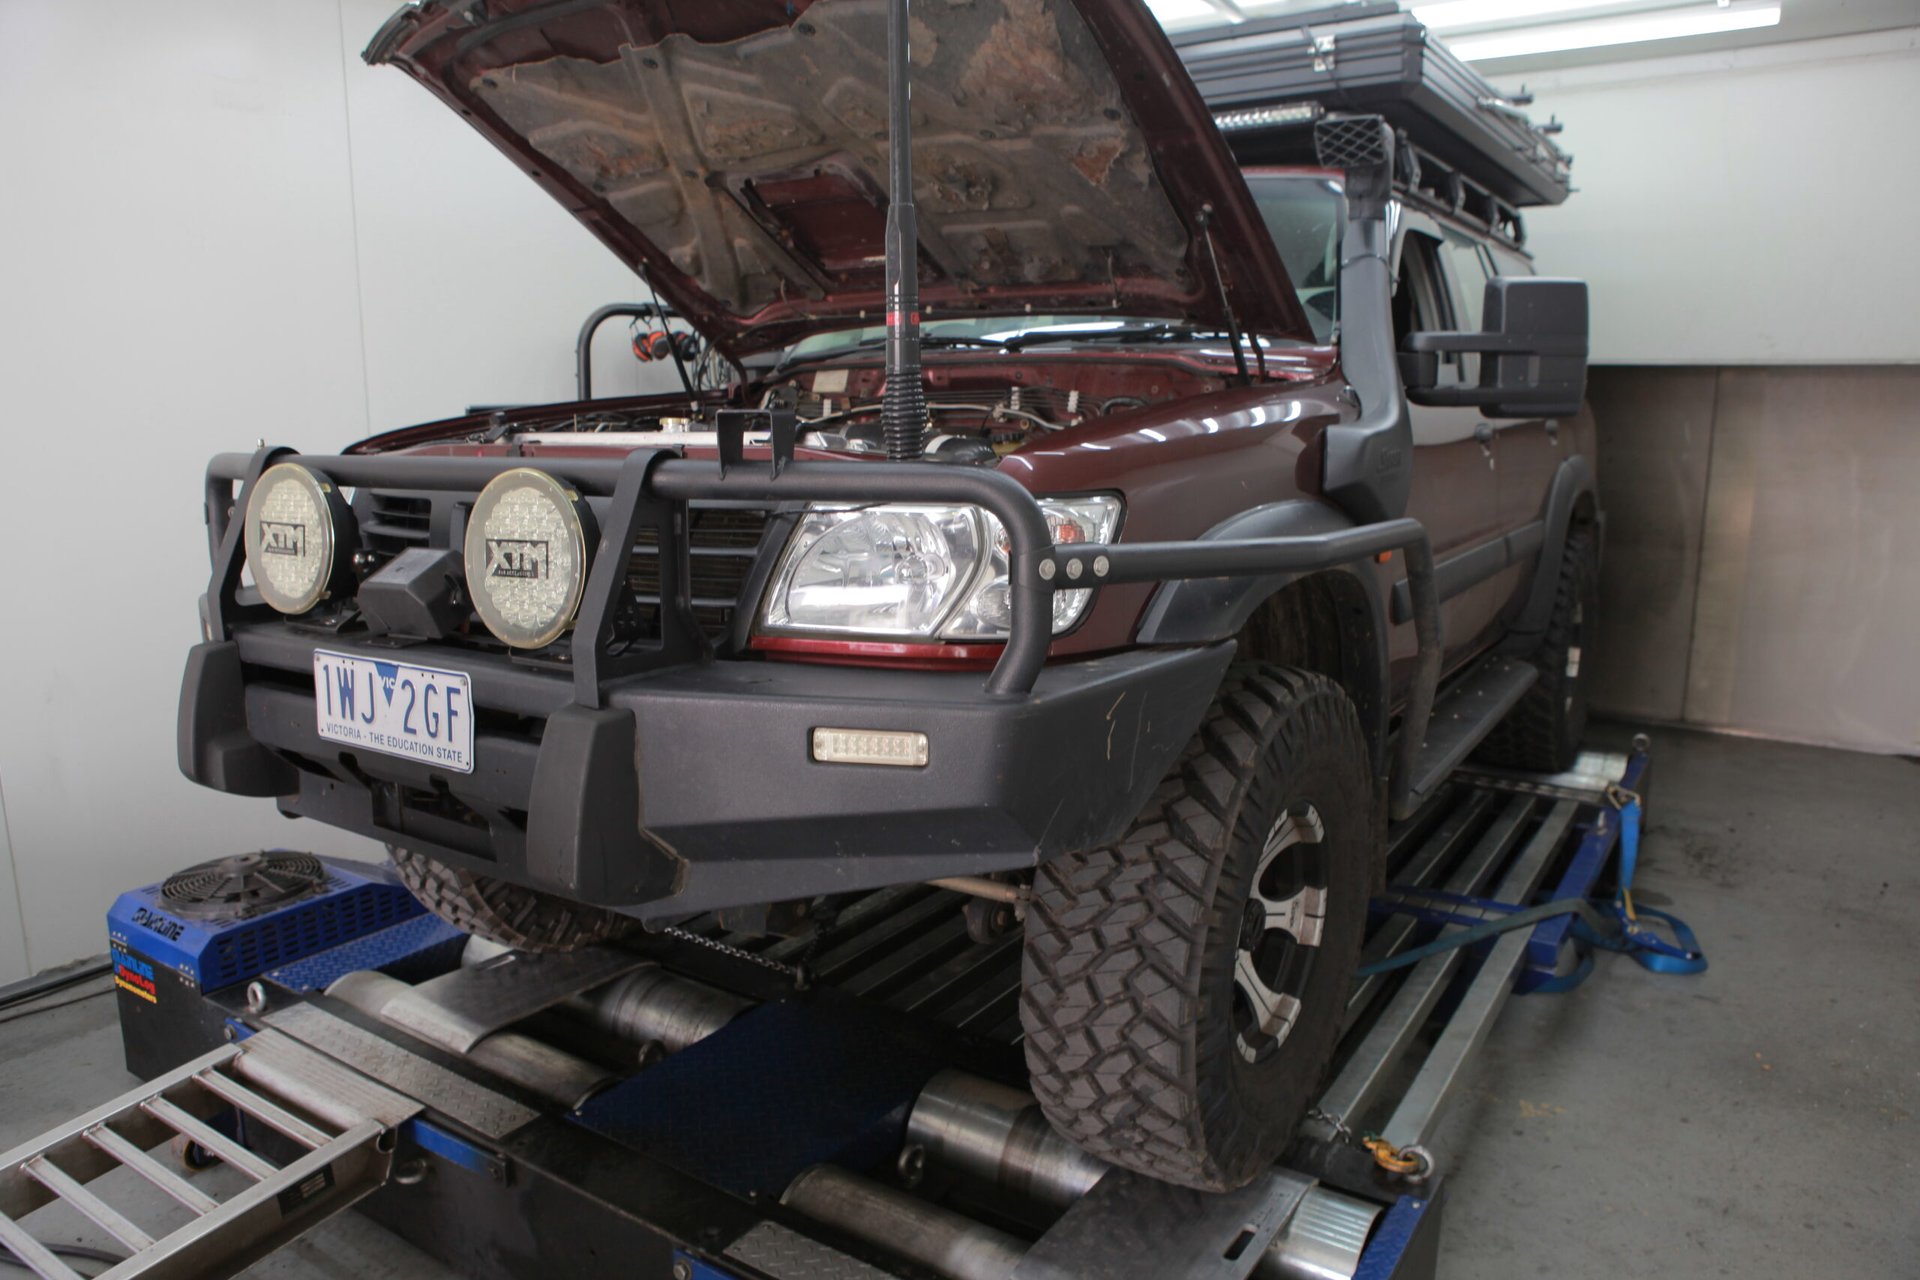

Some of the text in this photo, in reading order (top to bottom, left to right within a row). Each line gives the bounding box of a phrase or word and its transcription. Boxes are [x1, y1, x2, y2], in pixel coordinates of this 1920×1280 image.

[260, 522, 304, 557] XTM
[486, 540, 546, 578] XTM
[381, 676, 396, 689] VIC
[323, 664, 461, 742] 1WJ 2GF
[326, 723, 362, 740] VICTORIA
[369, 732, 385, 745] THE
[387, 735, 434, 757] EDUCATION
[436, 747, 463, 763] STATE
